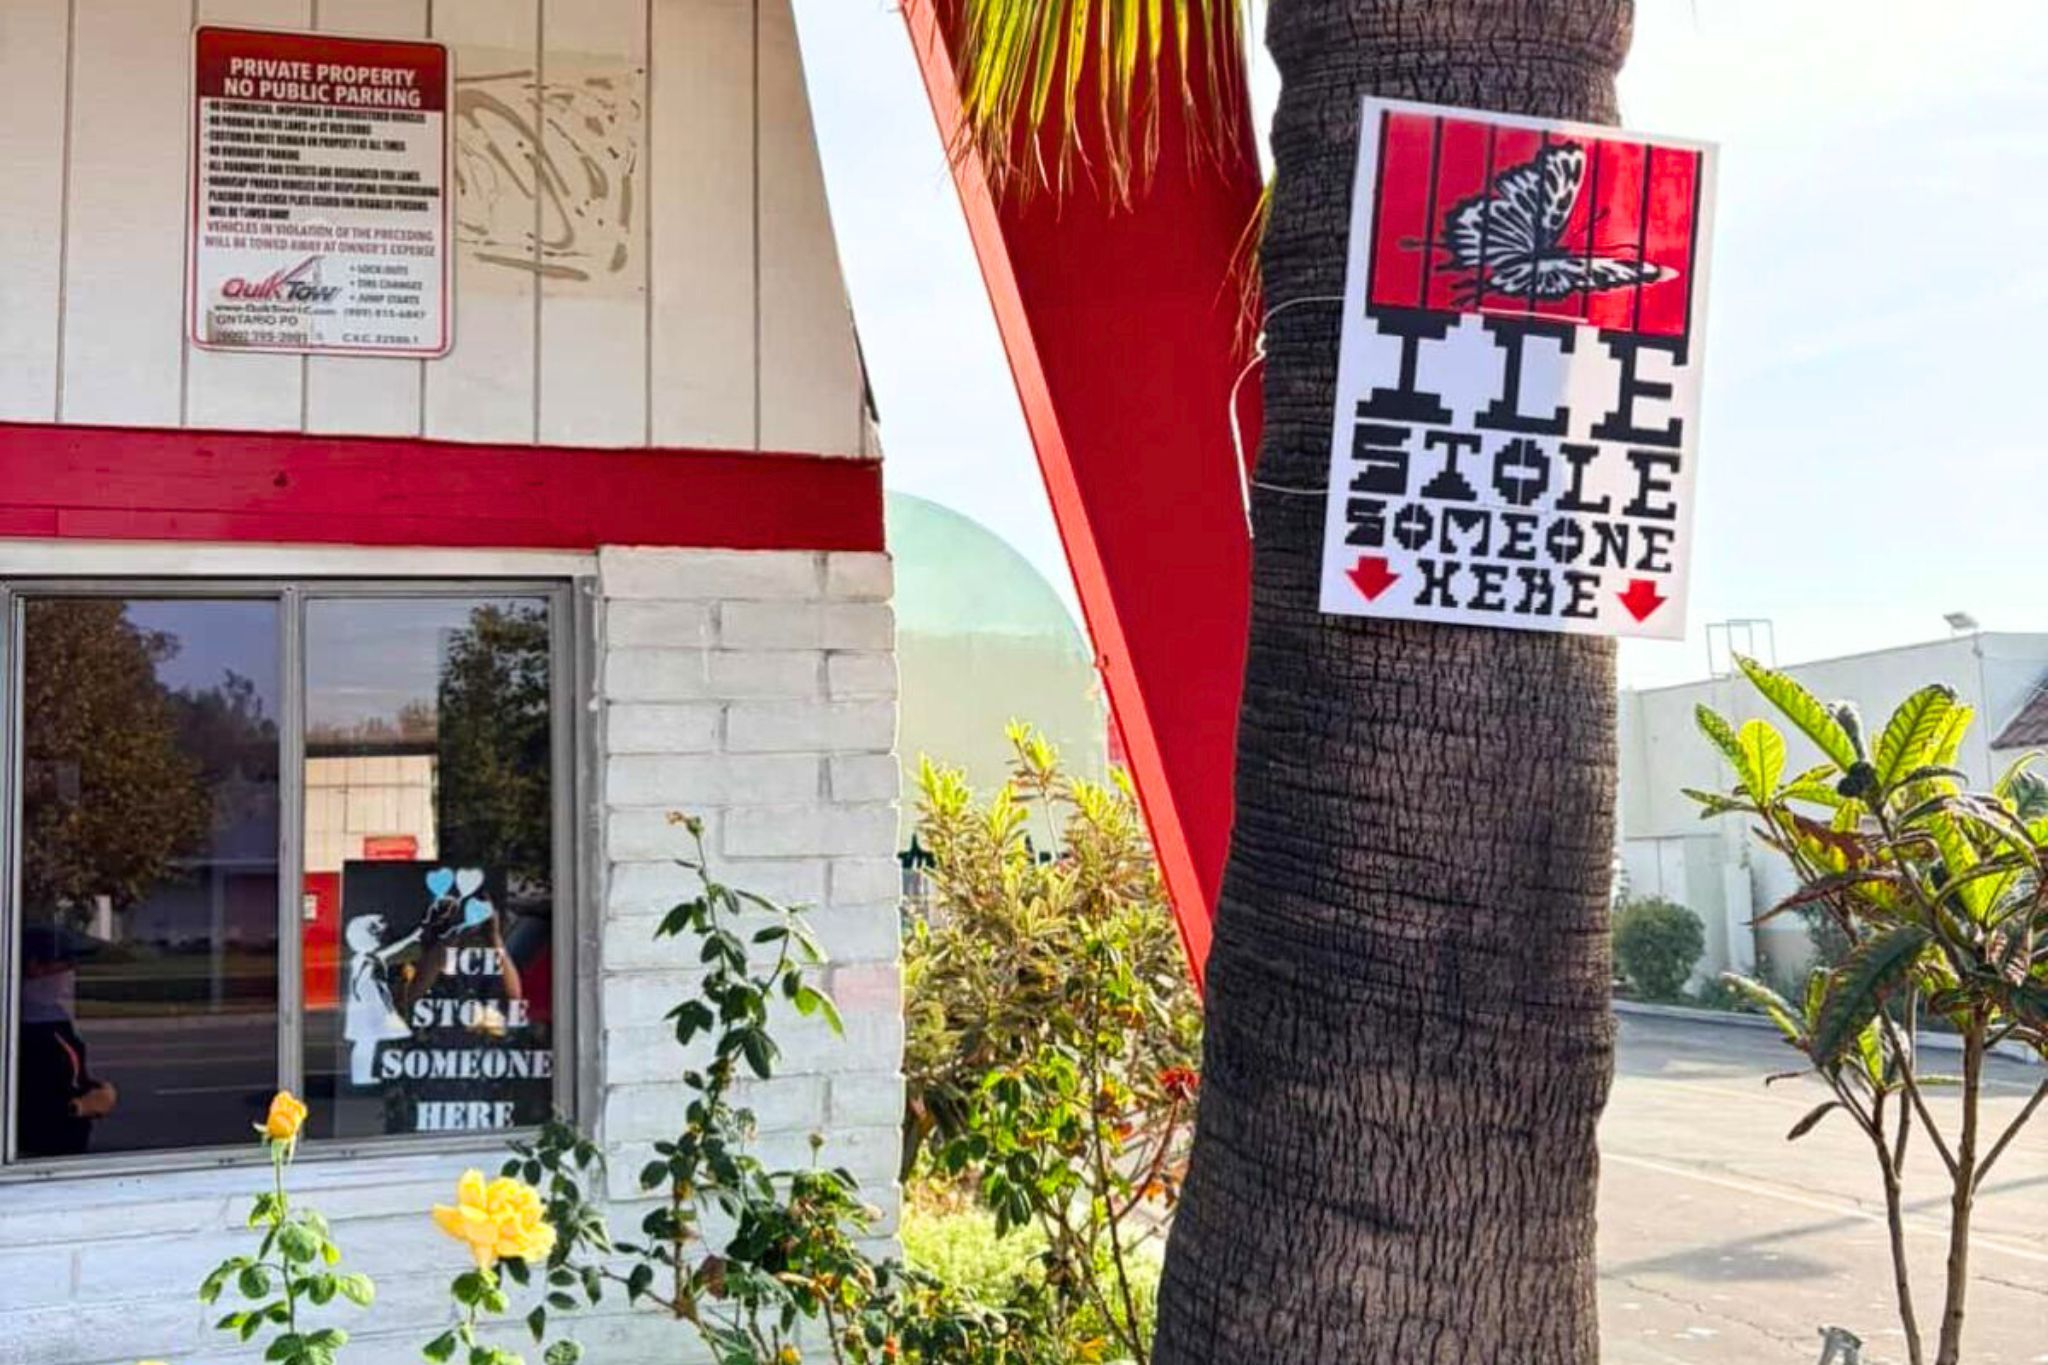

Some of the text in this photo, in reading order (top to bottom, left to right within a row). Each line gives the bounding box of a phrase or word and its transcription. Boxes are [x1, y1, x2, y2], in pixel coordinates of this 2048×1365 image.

[230, 57, 416, 86] PRIVATE PROPERTY
[224, 77, 421, 108] NO PUBLIC PARKING
[1355, 309, 1688, 447] ICE
[1349, 423, 1681, 519] STOLE
[1345, 498, 1675, 573] SOMEONE
[1413, 558, 1601, 619] HERE
[443, 947, 504, 975] ICE
[412, 998, 530, 1028] STOLE
[381, 1050, 553, 1079] SOMEONE
[415, 1101, 515, 1131] HERE
